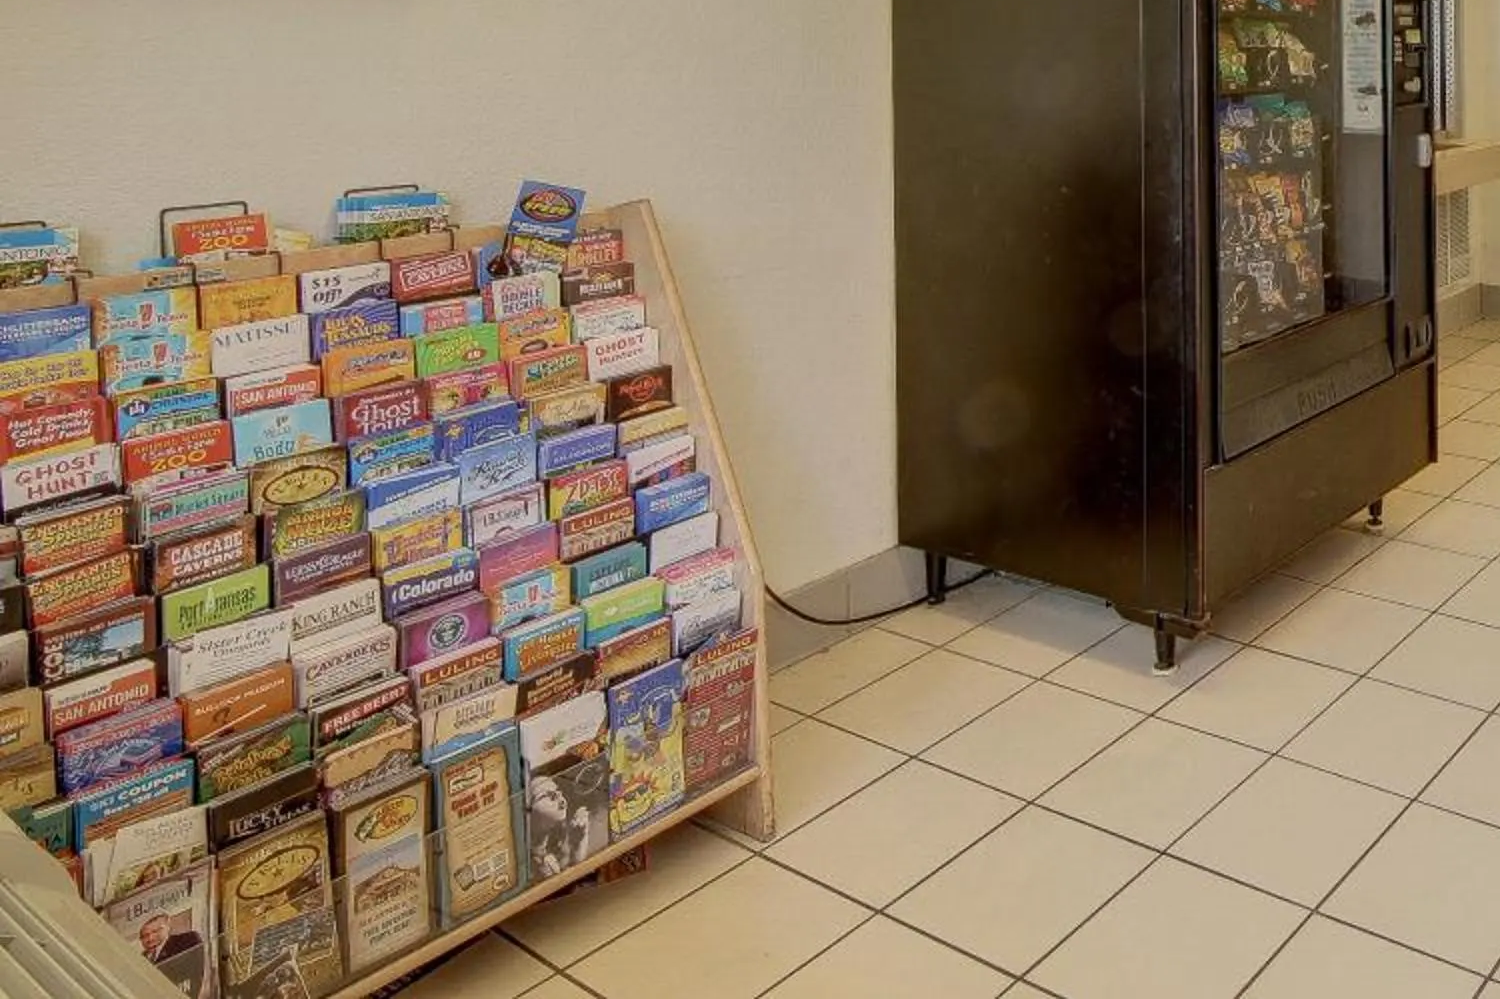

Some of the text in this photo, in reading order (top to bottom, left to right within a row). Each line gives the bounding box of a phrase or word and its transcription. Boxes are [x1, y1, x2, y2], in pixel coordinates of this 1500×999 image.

[200, 235, 247, 249] ZOO
[595, 334, 645, 356] GHOST
[240, 388, 265, 403] SAN
[351, 395, 419, 423] Ghost
[12, 426, 41, 440] Cold
[16, 453, 98, 484] GHOST
[151, 450, 207, 472] ZOO
[27, 472, 92, 501] HUNT
[27, 507, 122, 540] ENCHANTED
[571, 504, 632, 532] LULING
[171, 531, 243, 566] CASCADE
[32, 555, 130, 597] ENCHANTED
[173, 551, 243, 577] CAVERNS
[400, 568, 474, 599] Colorado
[292, 609, 328, 632] KING
[331, 590, 376, 618] RANCH
[198, 634, 241, 653] Sister
[697, 637, 752, 664] LULING
[424, 648, 498, 685] LULING
[55, 706, 84, 727] SAN
[87, 683, 149, 715] ANTONIO
[324, 708, 362, 734] FREE
[116, 768, 188, 800] COUPON
[228, 801, 283, 838] LUCKY
